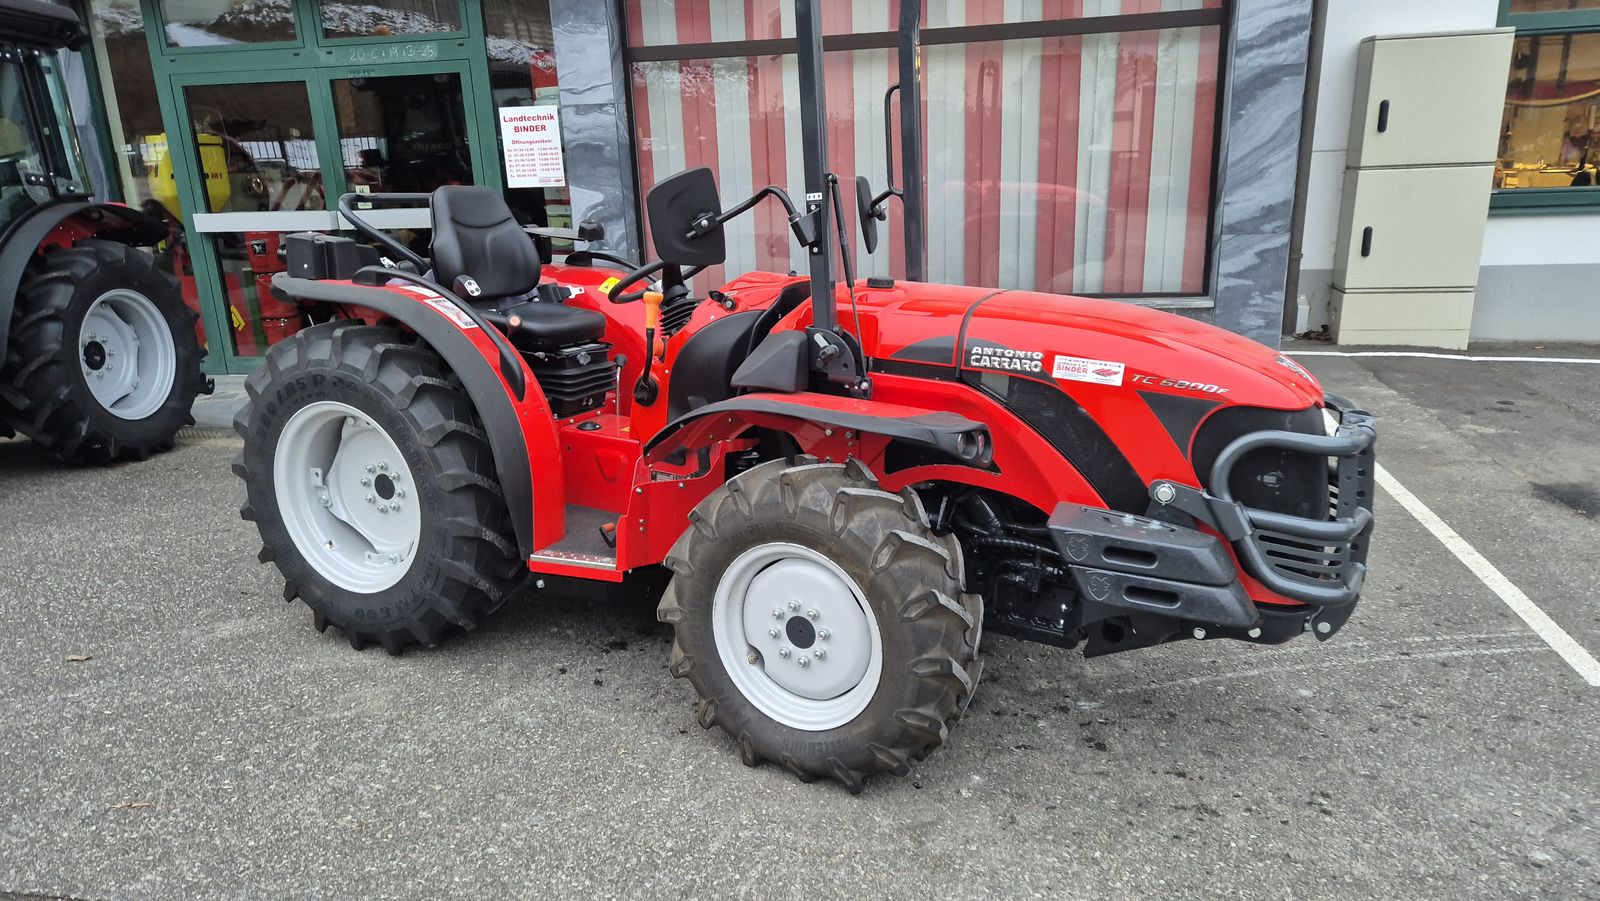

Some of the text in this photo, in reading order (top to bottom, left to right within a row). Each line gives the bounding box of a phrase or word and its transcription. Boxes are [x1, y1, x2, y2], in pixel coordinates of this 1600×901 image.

[503, 113, 555, 122] Landtechnik
[514, 125, 547, 133] BINDER
[971, 346, 1044, 360] ANTONIO
[970, 355, 1043, 372] CARRARO
[1056, 364, 1088, 374] BINDER
[1132, 374, 1158, 384] TC
